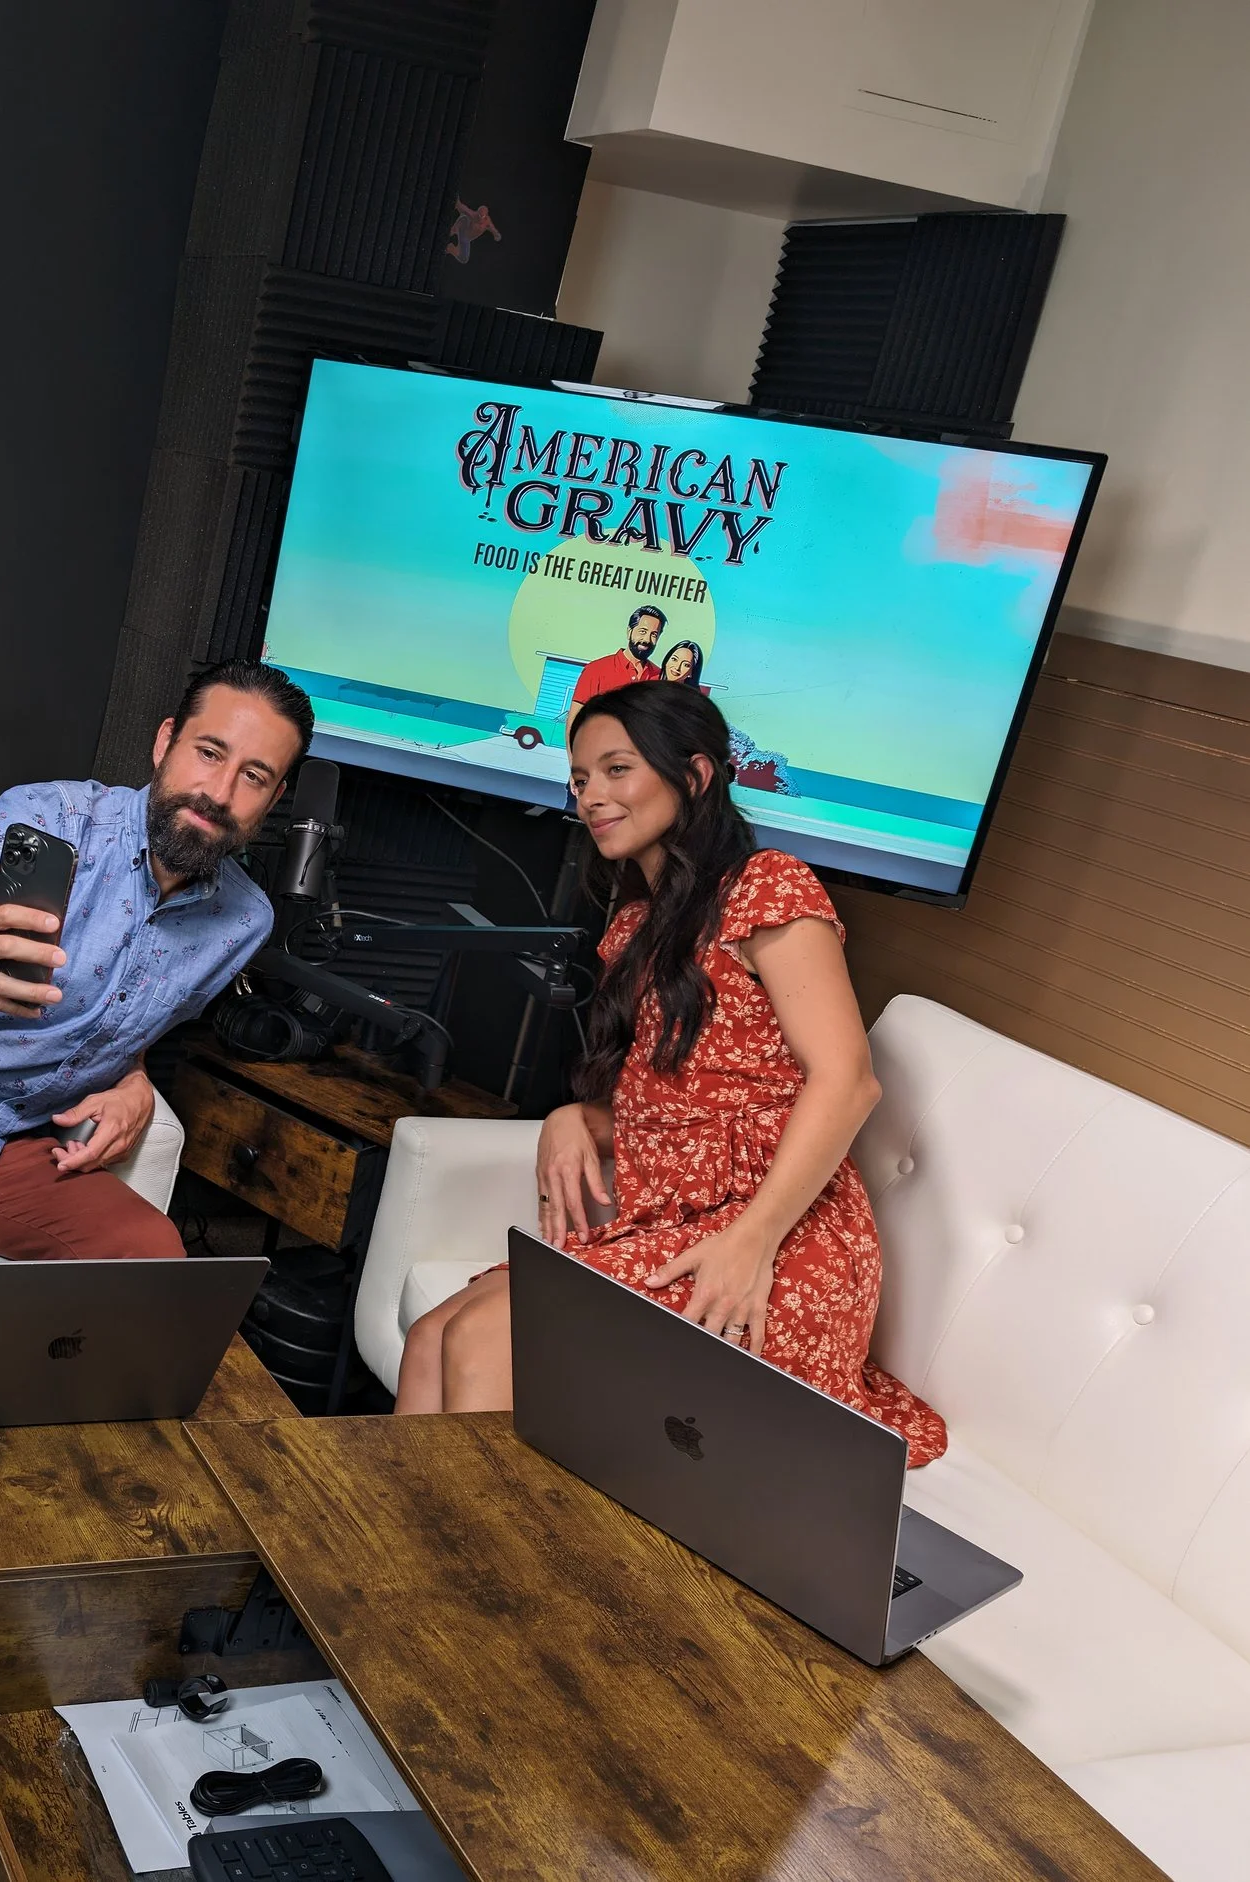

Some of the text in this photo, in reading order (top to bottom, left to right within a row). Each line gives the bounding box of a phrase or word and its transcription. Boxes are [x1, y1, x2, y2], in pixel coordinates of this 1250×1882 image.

[456, 401, 789, 511] AMERICAN
[505, 479, 775, 567] GRAVY
[474, 542, 709, 604] FOOD IS THE GREAT UNIFIER
[174, 1800, 198, 1832] Tables
